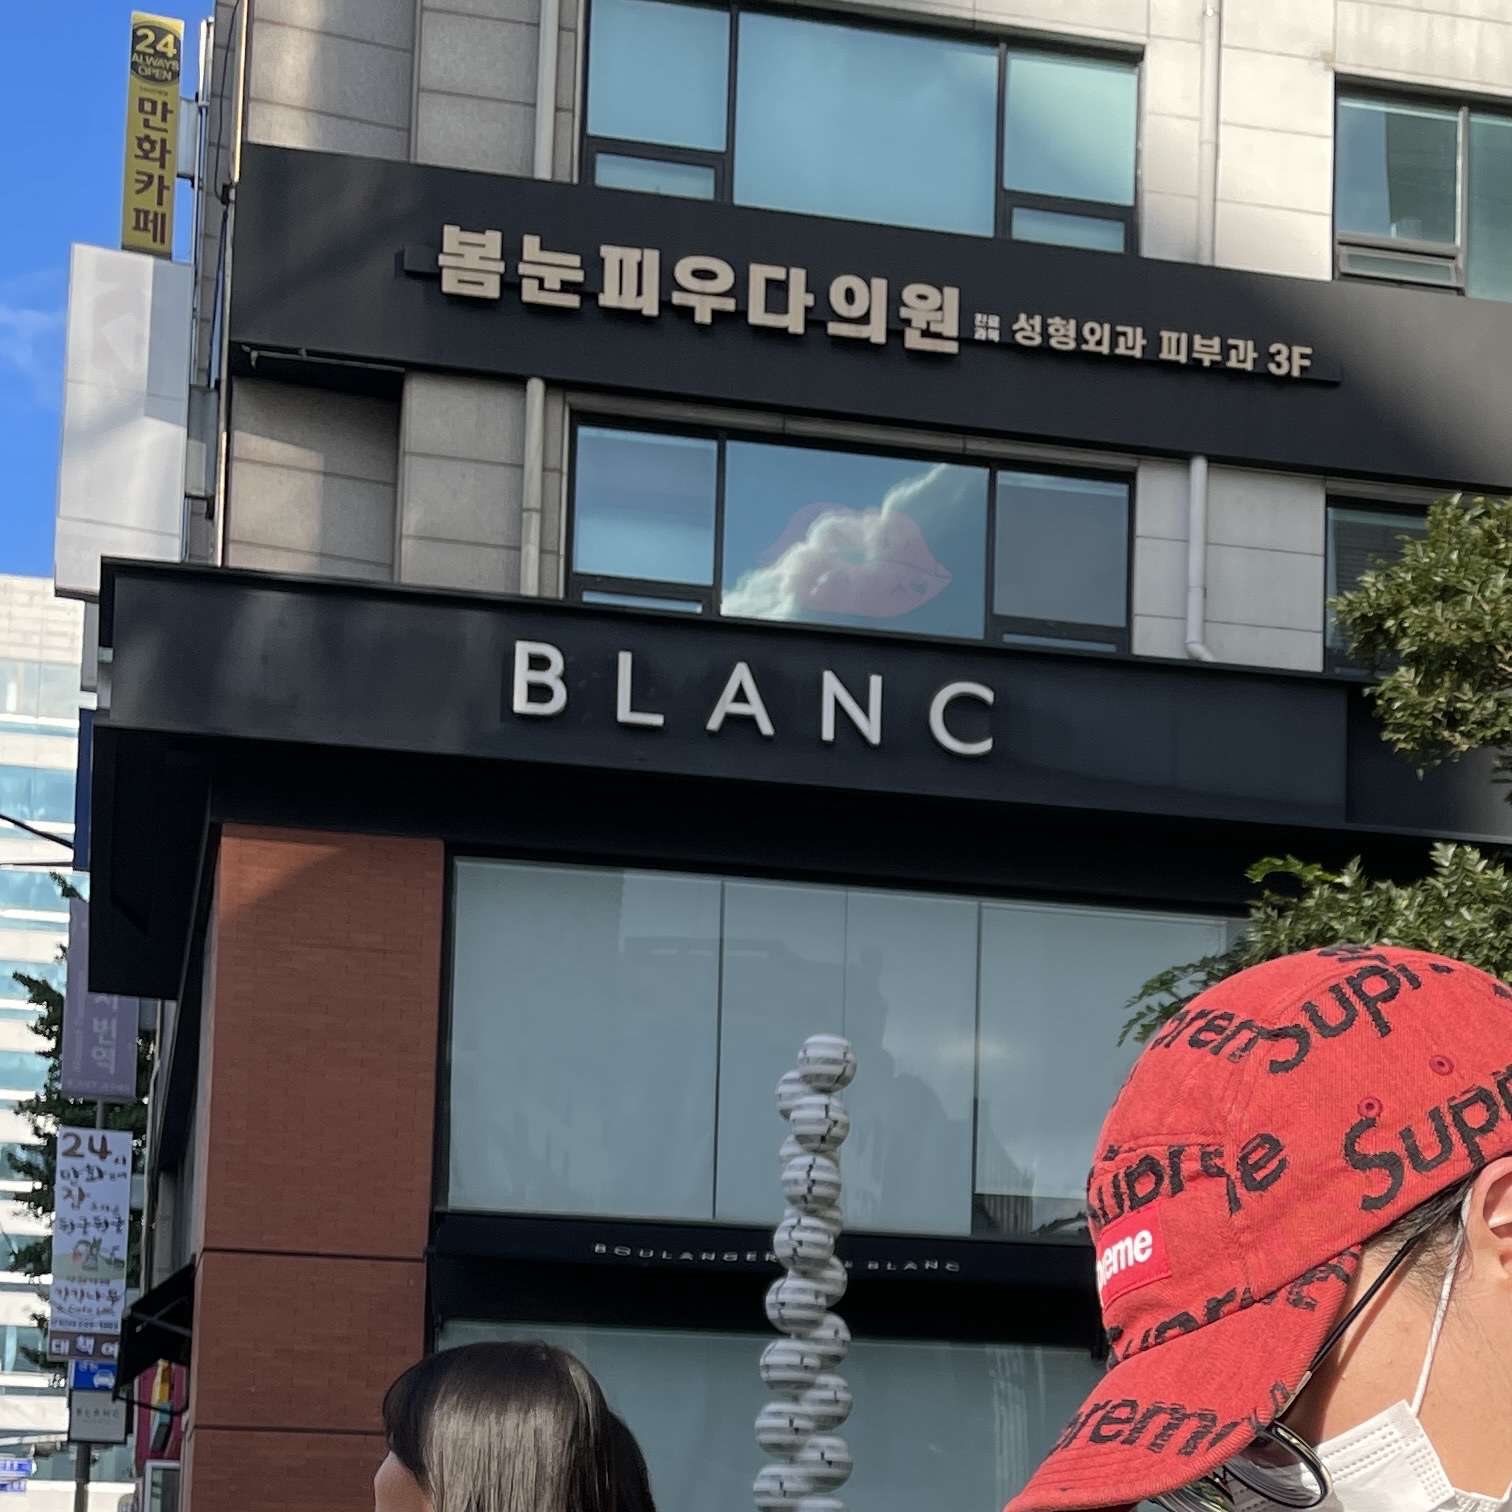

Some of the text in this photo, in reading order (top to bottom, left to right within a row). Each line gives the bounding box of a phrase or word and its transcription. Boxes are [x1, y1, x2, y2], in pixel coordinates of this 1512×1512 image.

[132, 53, 180, 71] ALWAYS
[136, 27, 177, 58] 24
[138, 66, 172, 81] OPEN
[132, 97, 174, 244] 만화카페
[438, 224, 960, 354] 봄눈피우다의원
[1012, 312, 1313, 378] 성형외과 피부과 3F
[513, 639, 995, 756] BLANC
[868, 1260, 960, 1272] BLANC
